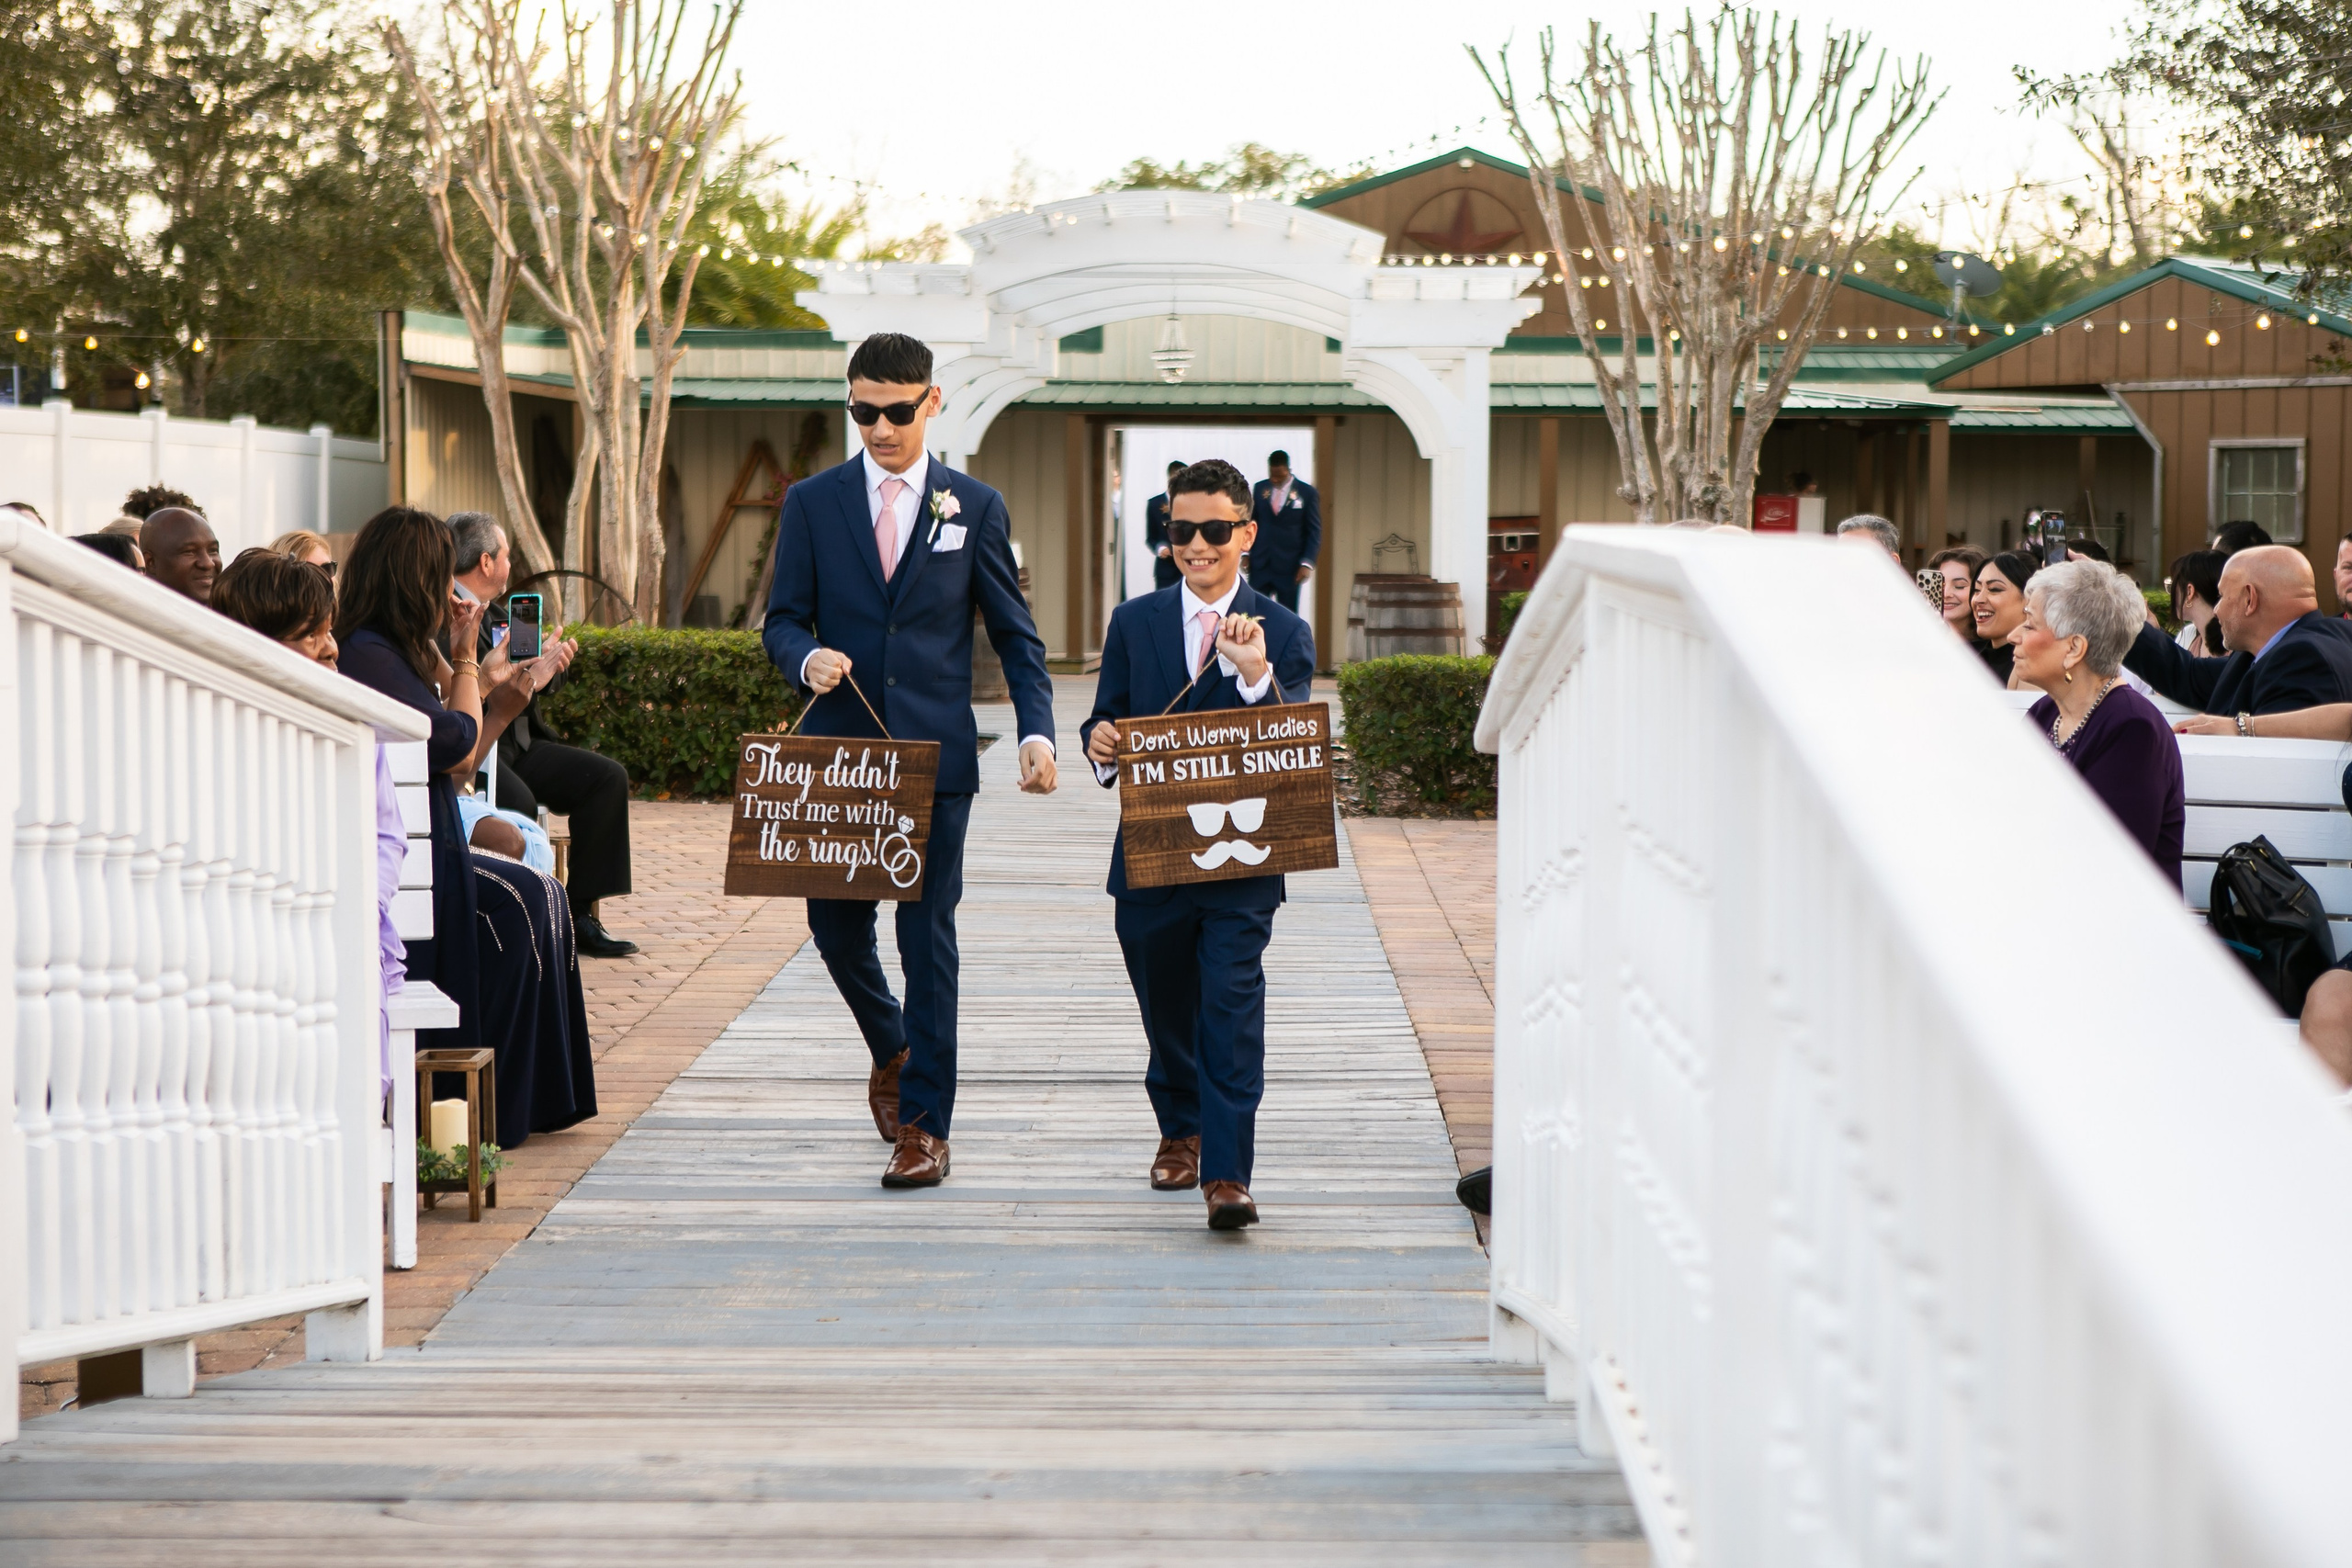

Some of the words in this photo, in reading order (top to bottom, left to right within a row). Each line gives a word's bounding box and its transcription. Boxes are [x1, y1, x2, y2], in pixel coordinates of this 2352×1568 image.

[1130, 729, 1181, 751] Dont
[1186, 723, 1250, 748] Worry
[1257, 717, 1317, 740] Ladies
[745, 743, 815, 804] They
[823, 747, 900, 790] didn't
[1132, 761, 1165, 784] I'M
[1172, 755, 1236, 781] STILL
[1242, 746, 1323, 773] SINGLE
[741, 794, 800, 820] Trust
[804, 804, 839, 823] me
[845, 799, 894, 825] with
[760, 821, 799, 861] the
[808, 828, 880, 882] rings!
